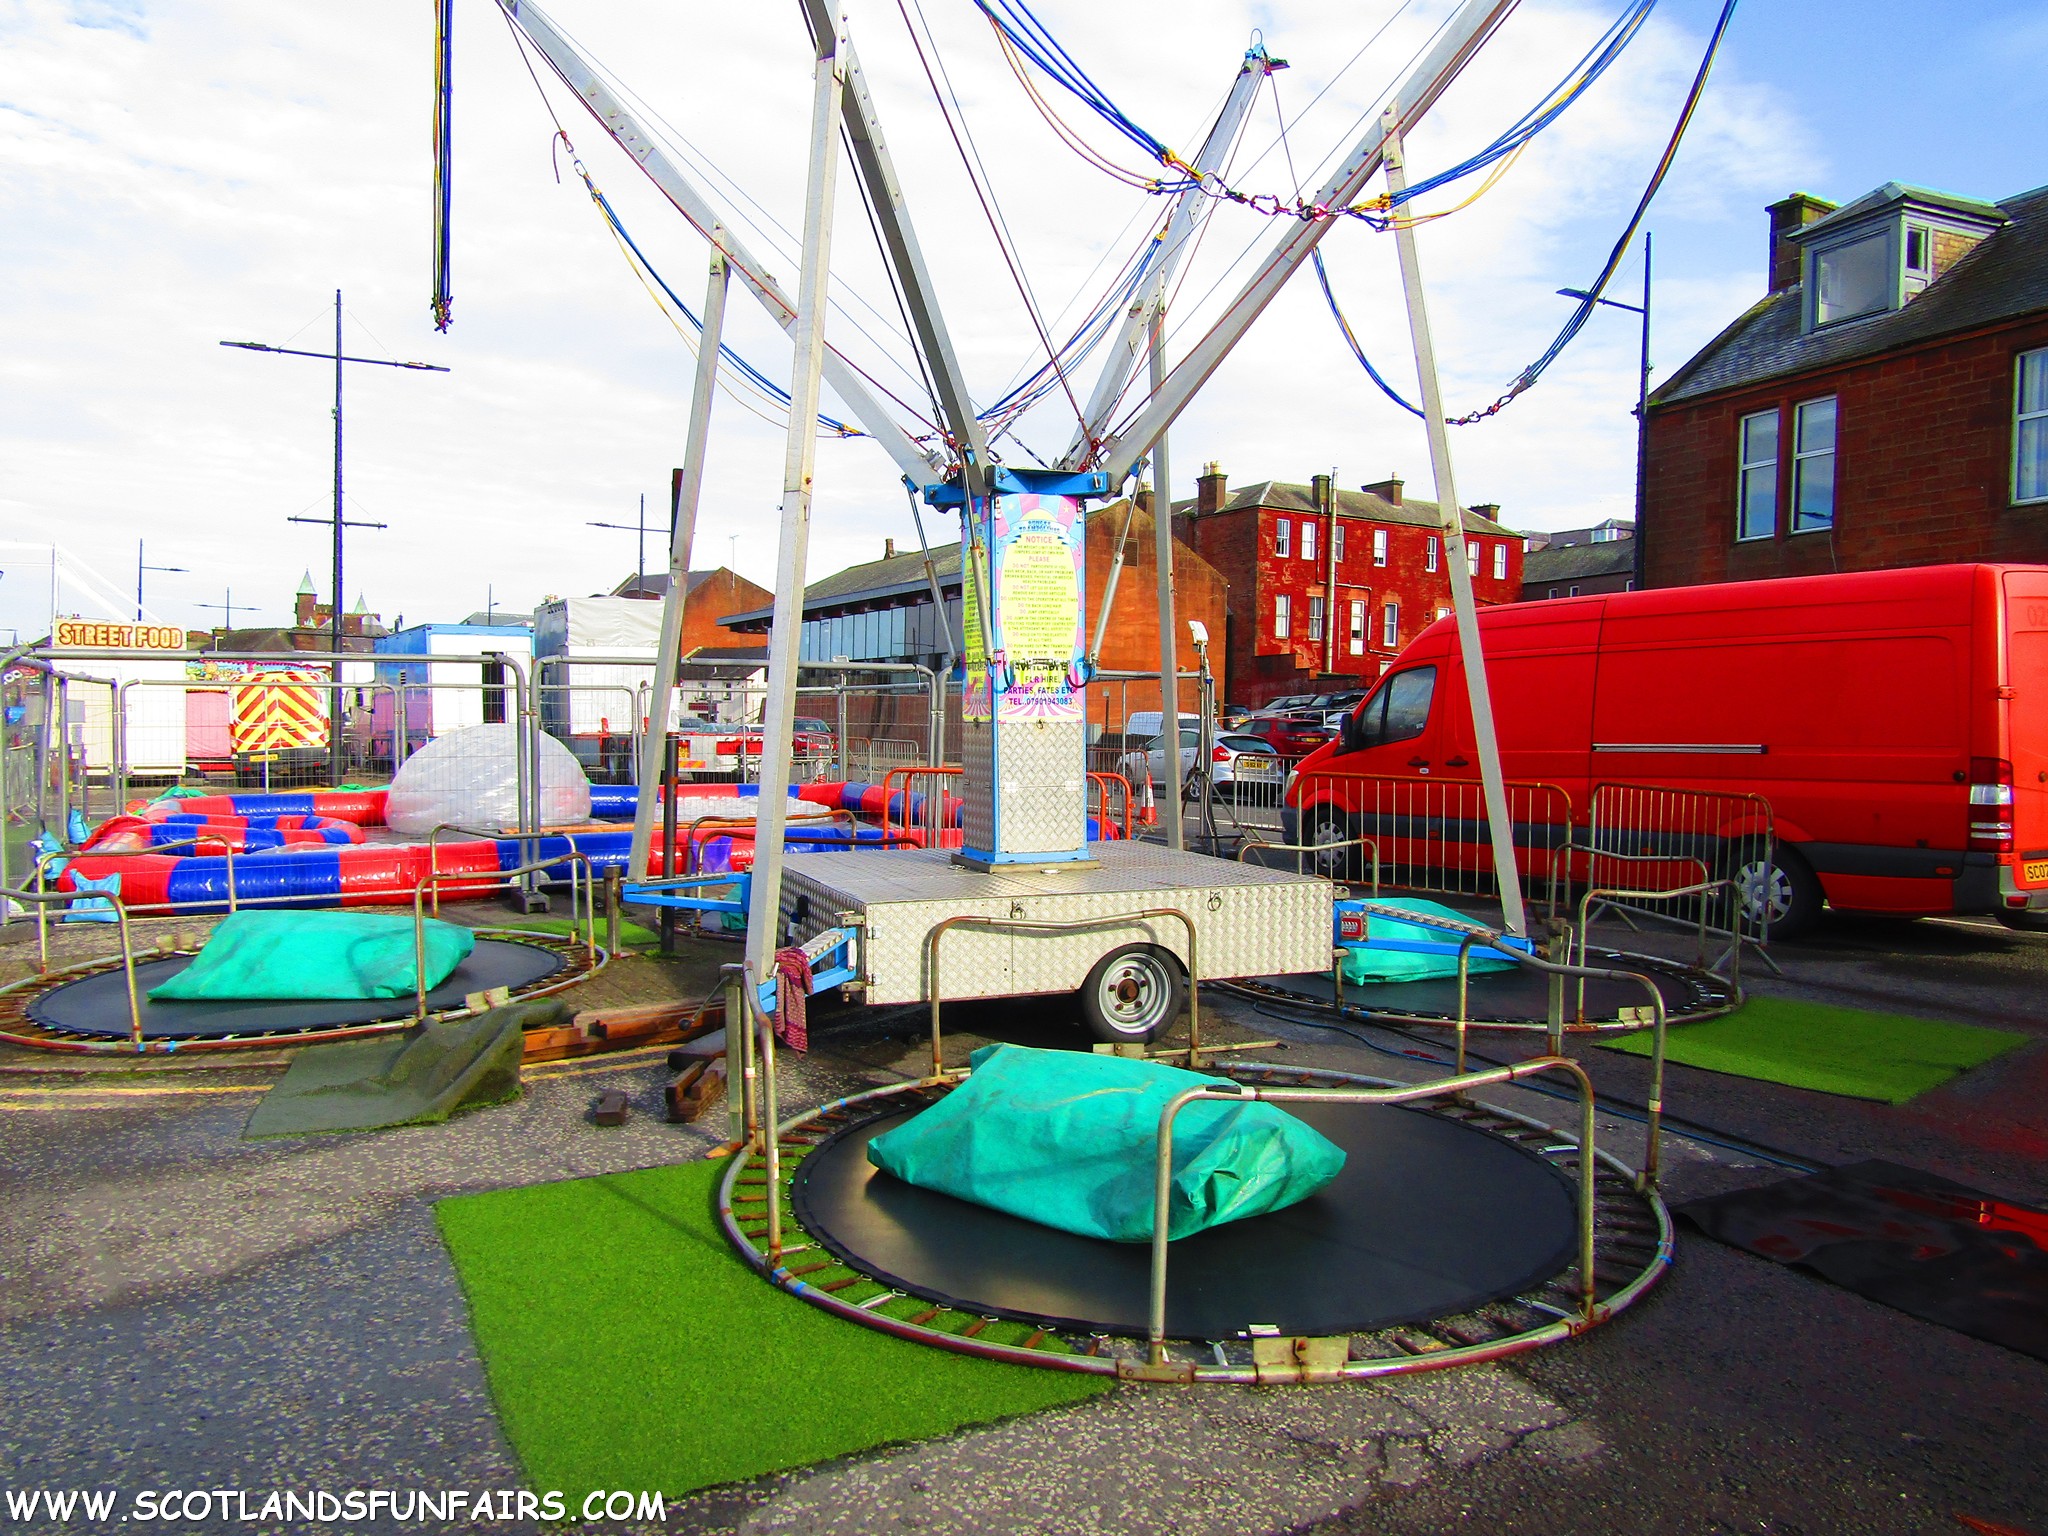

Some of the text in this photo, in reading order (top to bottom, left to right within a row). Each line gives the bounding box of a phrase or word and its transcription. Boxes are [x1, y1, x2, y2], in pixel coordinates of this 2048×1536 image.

[59, 623, 183, 649] STREET FOOD
[1037, 686, 1060, 694] FATES
